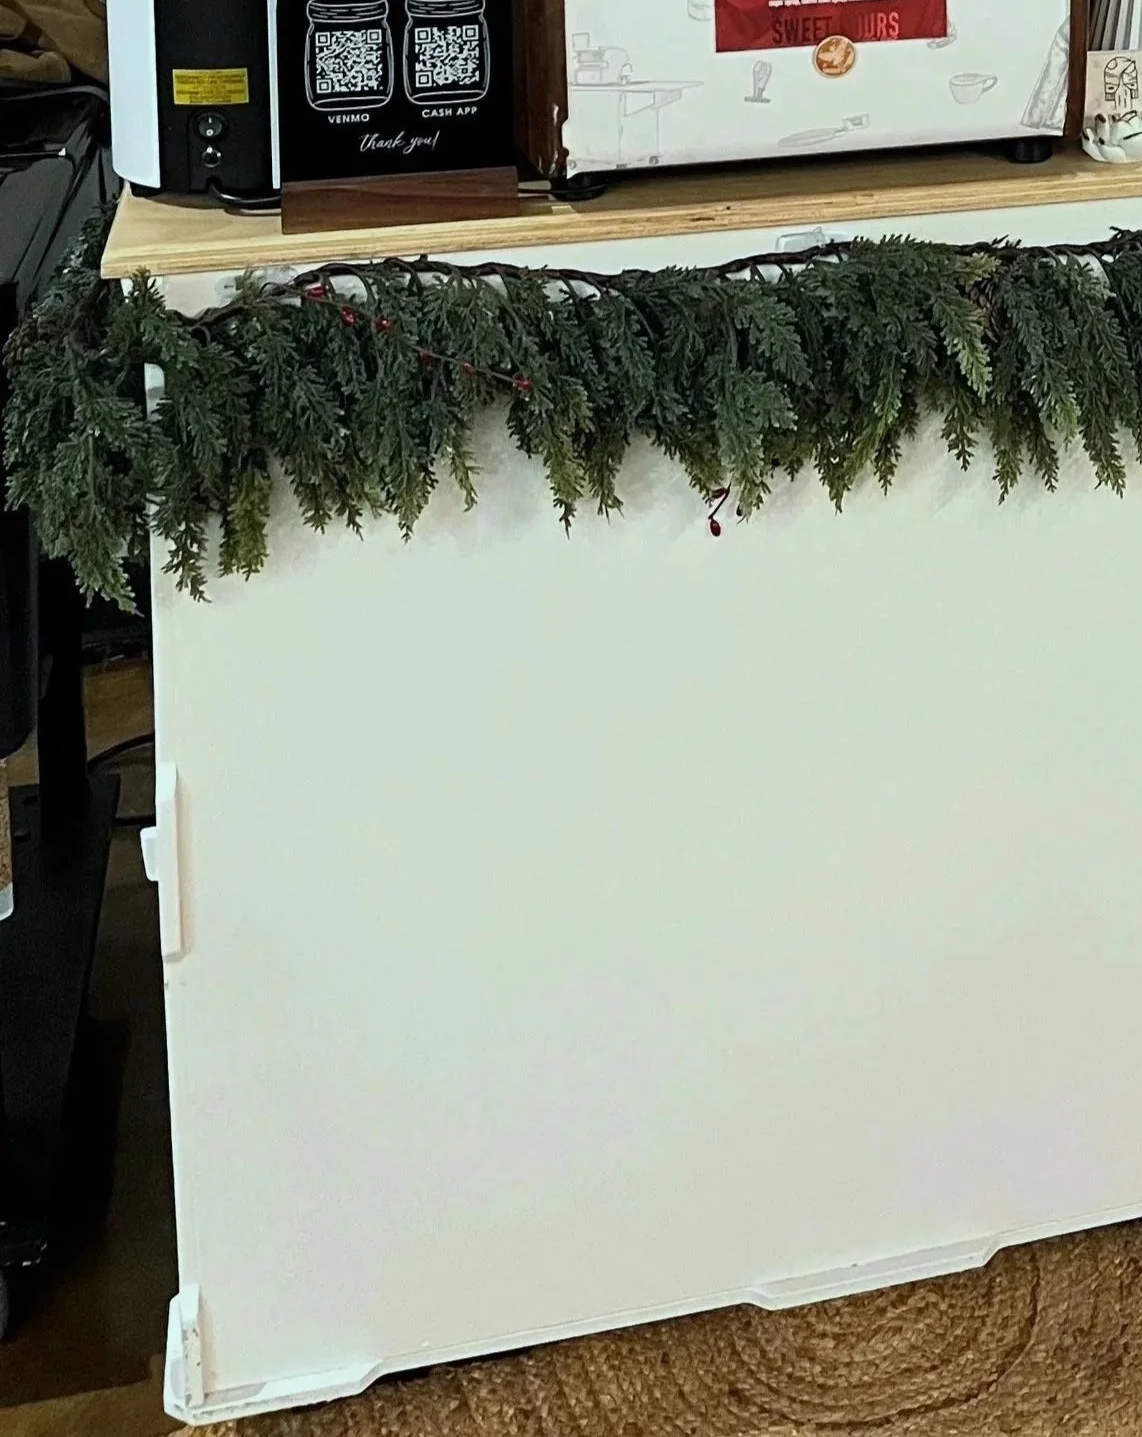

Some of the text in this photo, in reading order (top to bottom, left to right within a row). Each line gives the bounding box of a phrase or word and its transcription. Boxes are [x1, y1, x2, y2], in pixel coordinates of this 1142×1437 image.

[771, 16, 833, 45] SWEET
[327, 113, 370, 124] VENMO
[421, 106, 478, 119] CASH APP
[402, 130, 440, 155] you!
